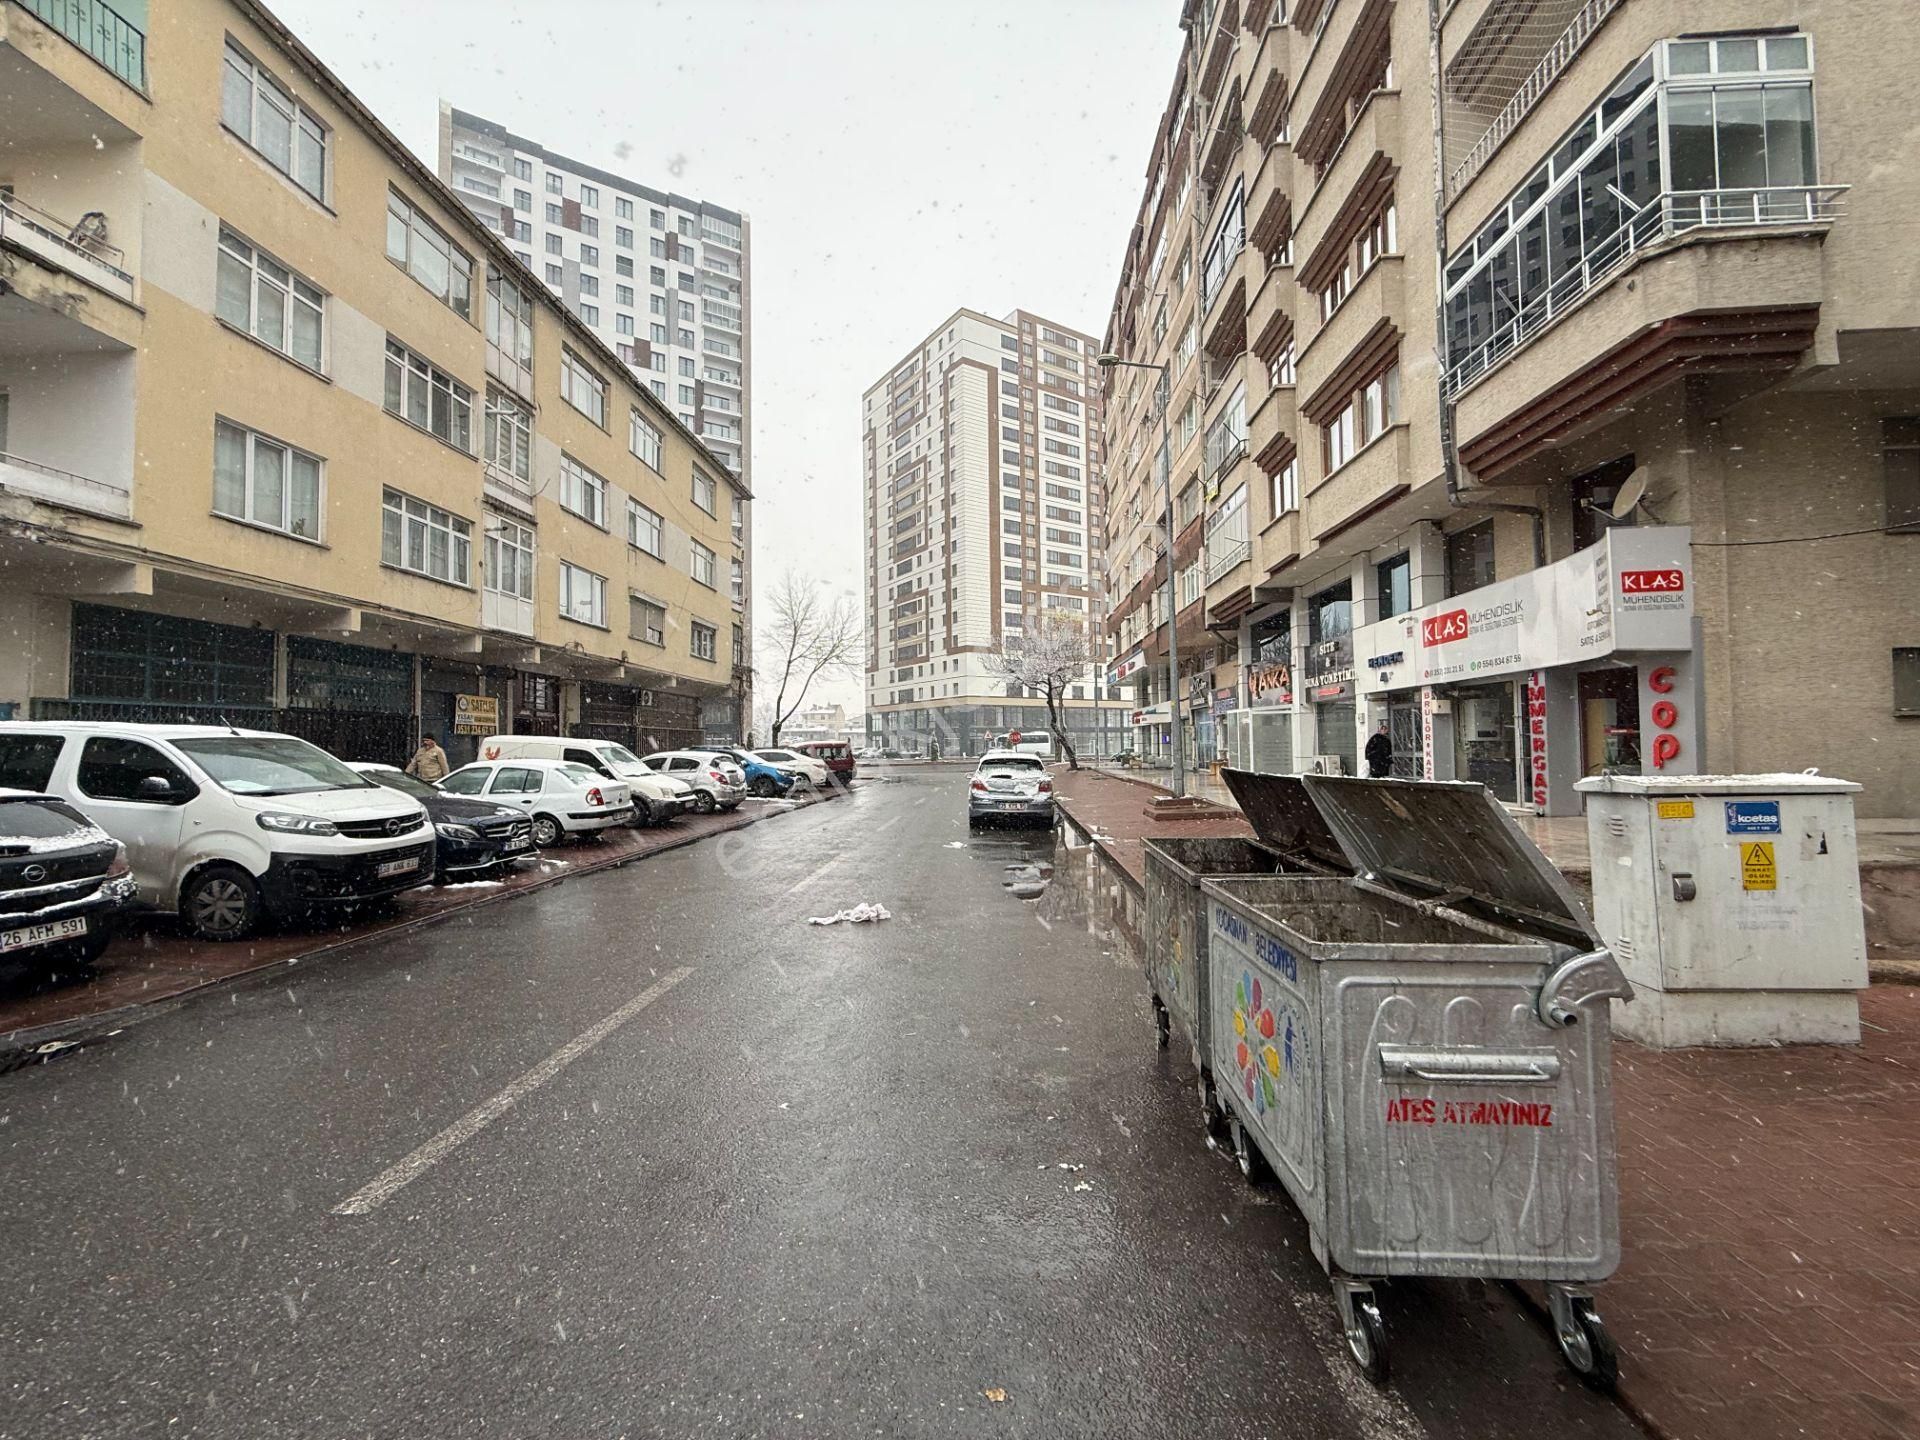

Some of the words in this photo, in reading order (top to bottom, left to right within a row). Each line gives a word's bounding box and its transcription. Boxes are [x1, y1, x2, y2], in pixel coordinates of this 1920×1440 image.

[1624, 572, 1681, 590] KLAS
[1424, 615, 1466, 643] KLAS
[3, 932, 21, 946] 26
[29, 924, 54, 941] AFM
[61, 918, 84, 933] 591
[1442, 1100, 1553, 1127] ATMAYINIZ
